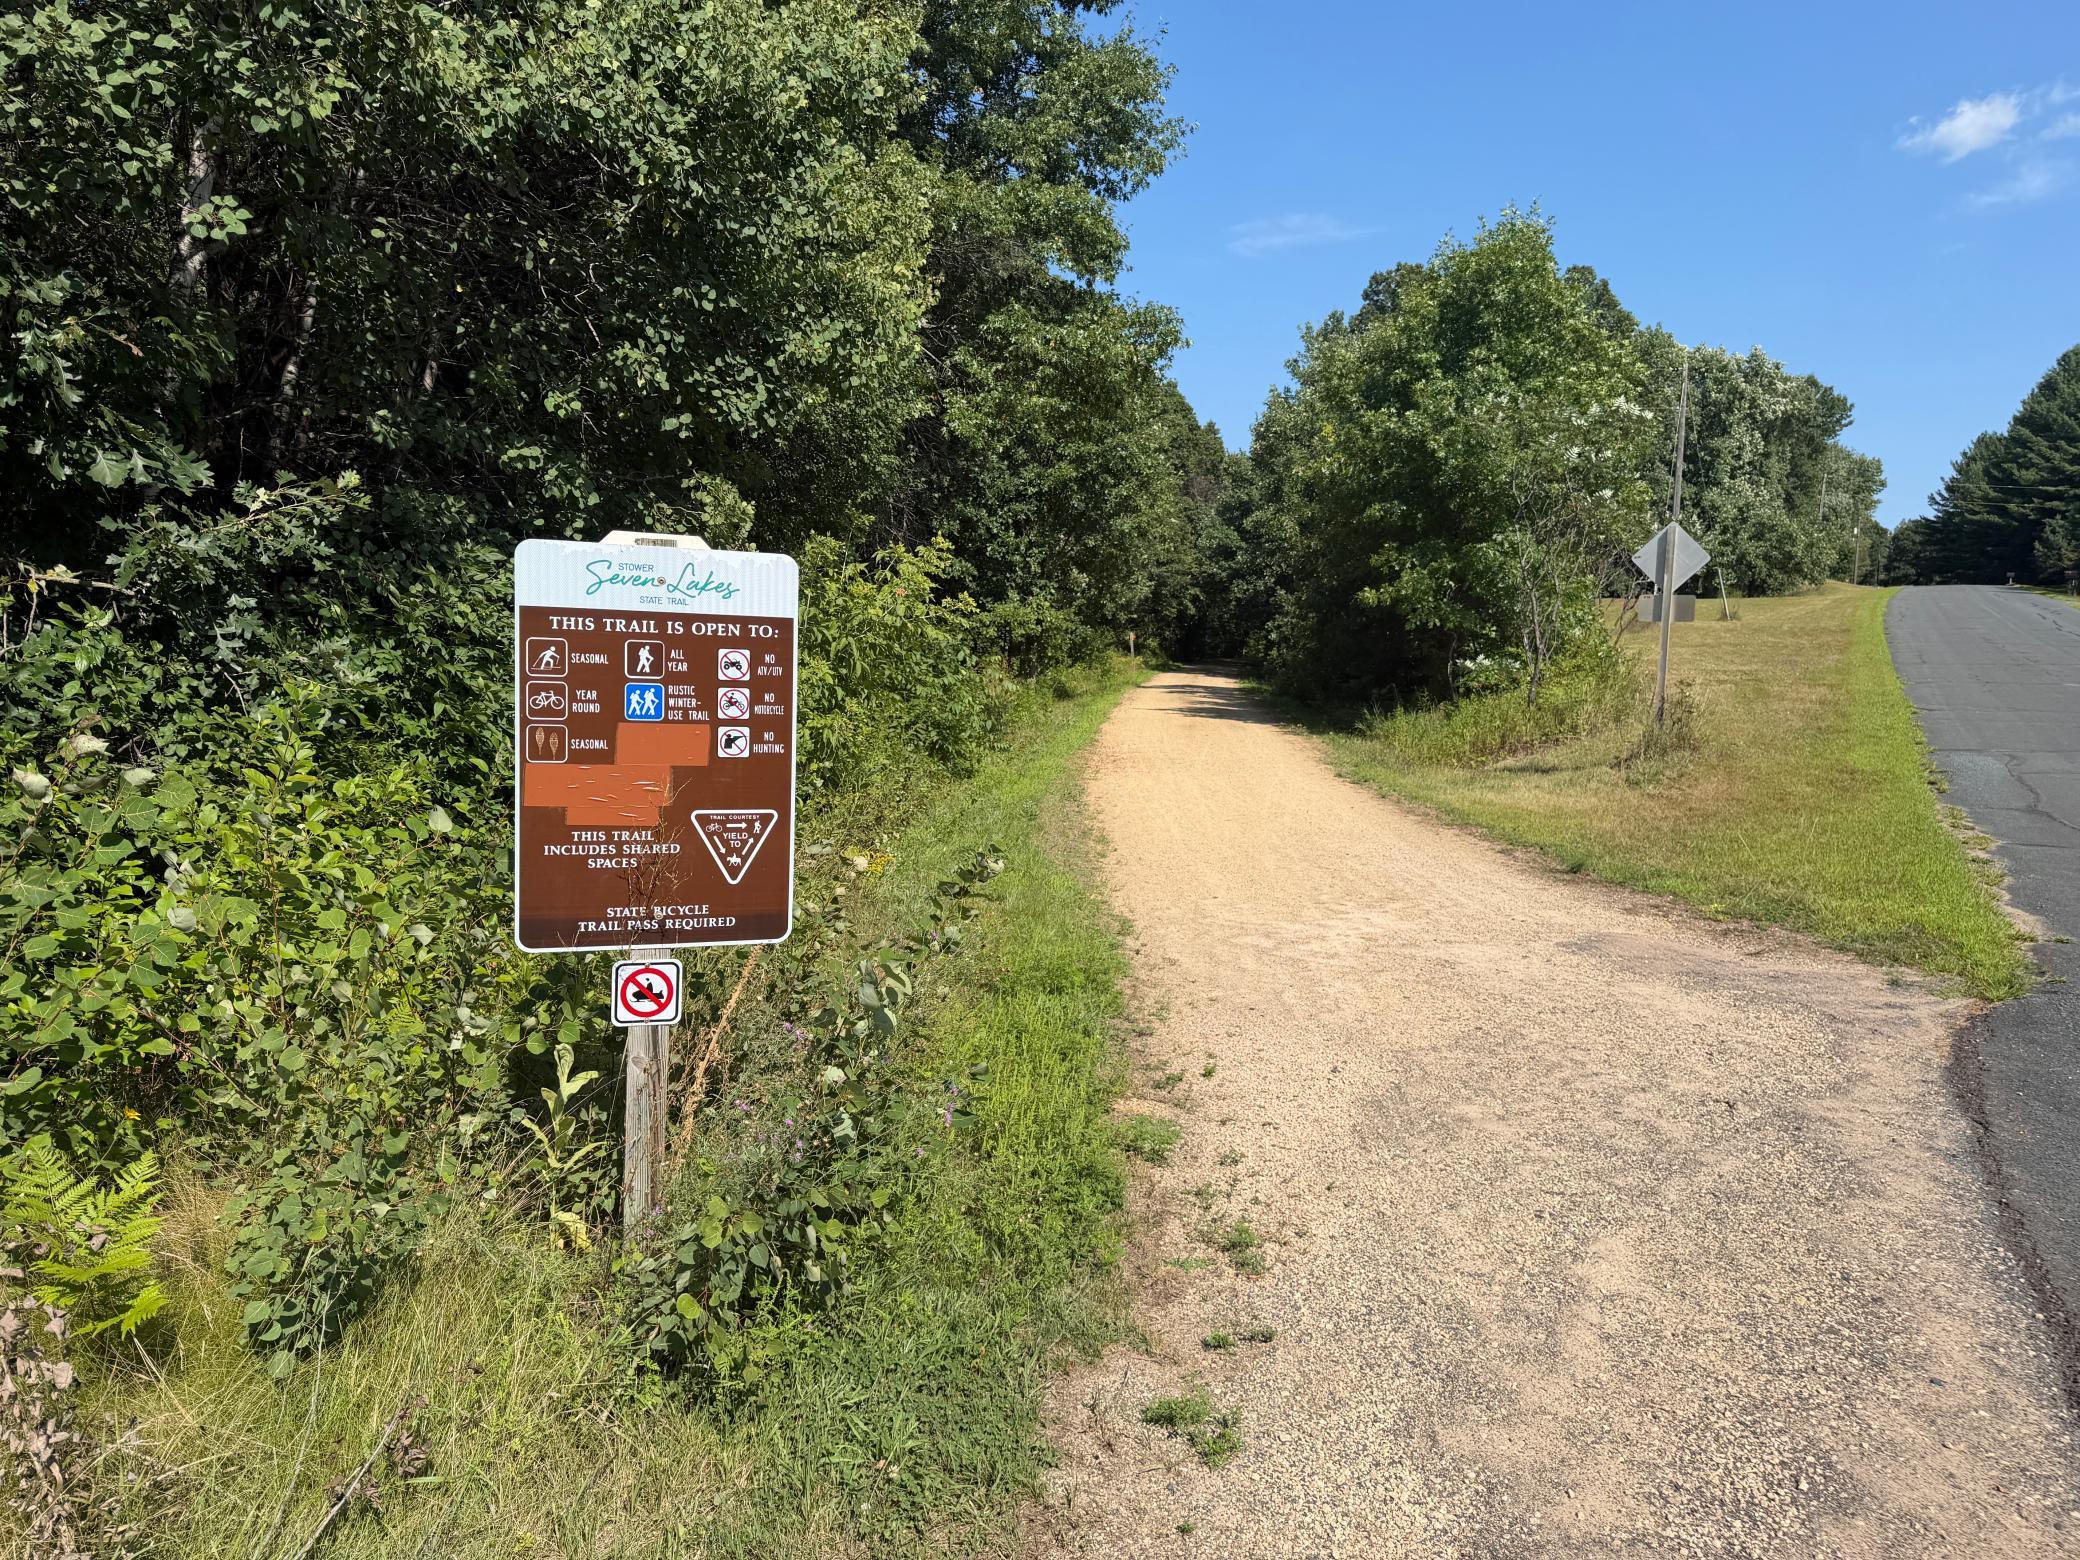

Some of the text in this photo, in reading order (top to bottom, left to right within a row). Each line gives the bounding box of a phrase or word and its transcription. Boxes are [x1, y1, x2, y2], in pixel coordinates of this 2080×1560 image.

[618, 562, 654, 573] STOWER
[586, 560, 740, 599] Seven Lakes
[639, 596, 689, 606] STATE TRAIL
[549, 616, 779, 638] THIS TRAIL IS OPEN TO:
[571, 653, 609, 665] SEASONAL
[670, 649, 684, 660] ALL
[764, 654, 776, 664] NO
[667, 662, 688, 672] YEAR
[757, 666, 783, 676] ATV/UTV
[576, 690, 597, 701] YEAR
[668, 685, 695, 696] RUSTIC
[668, 698, 701, 708] WINTER-
[764, 693, 775, 703] NO
[572, 703, 600, 713] ROUND
[754, 705, 785, 715] MOTORCYCLE
[668, 710, 710, 721] USE TRAIL
[763, 731, 774, 742] NO
[570, 739, 608, 750] SEASONAL
[753, 744, 785, 754] HUNTING
[571, 830, 655, 842] THIS TRAIL
[722, 832, 748, 840] YIELD
[544, 843, 681, 856] INCLUDES SHARED
[587, 858, 638, 869] SPACES
[606, 904, 710, 918] STATE BICYCLE
[578, 917, 736, 932] TRAIL PASS REQUIRED
